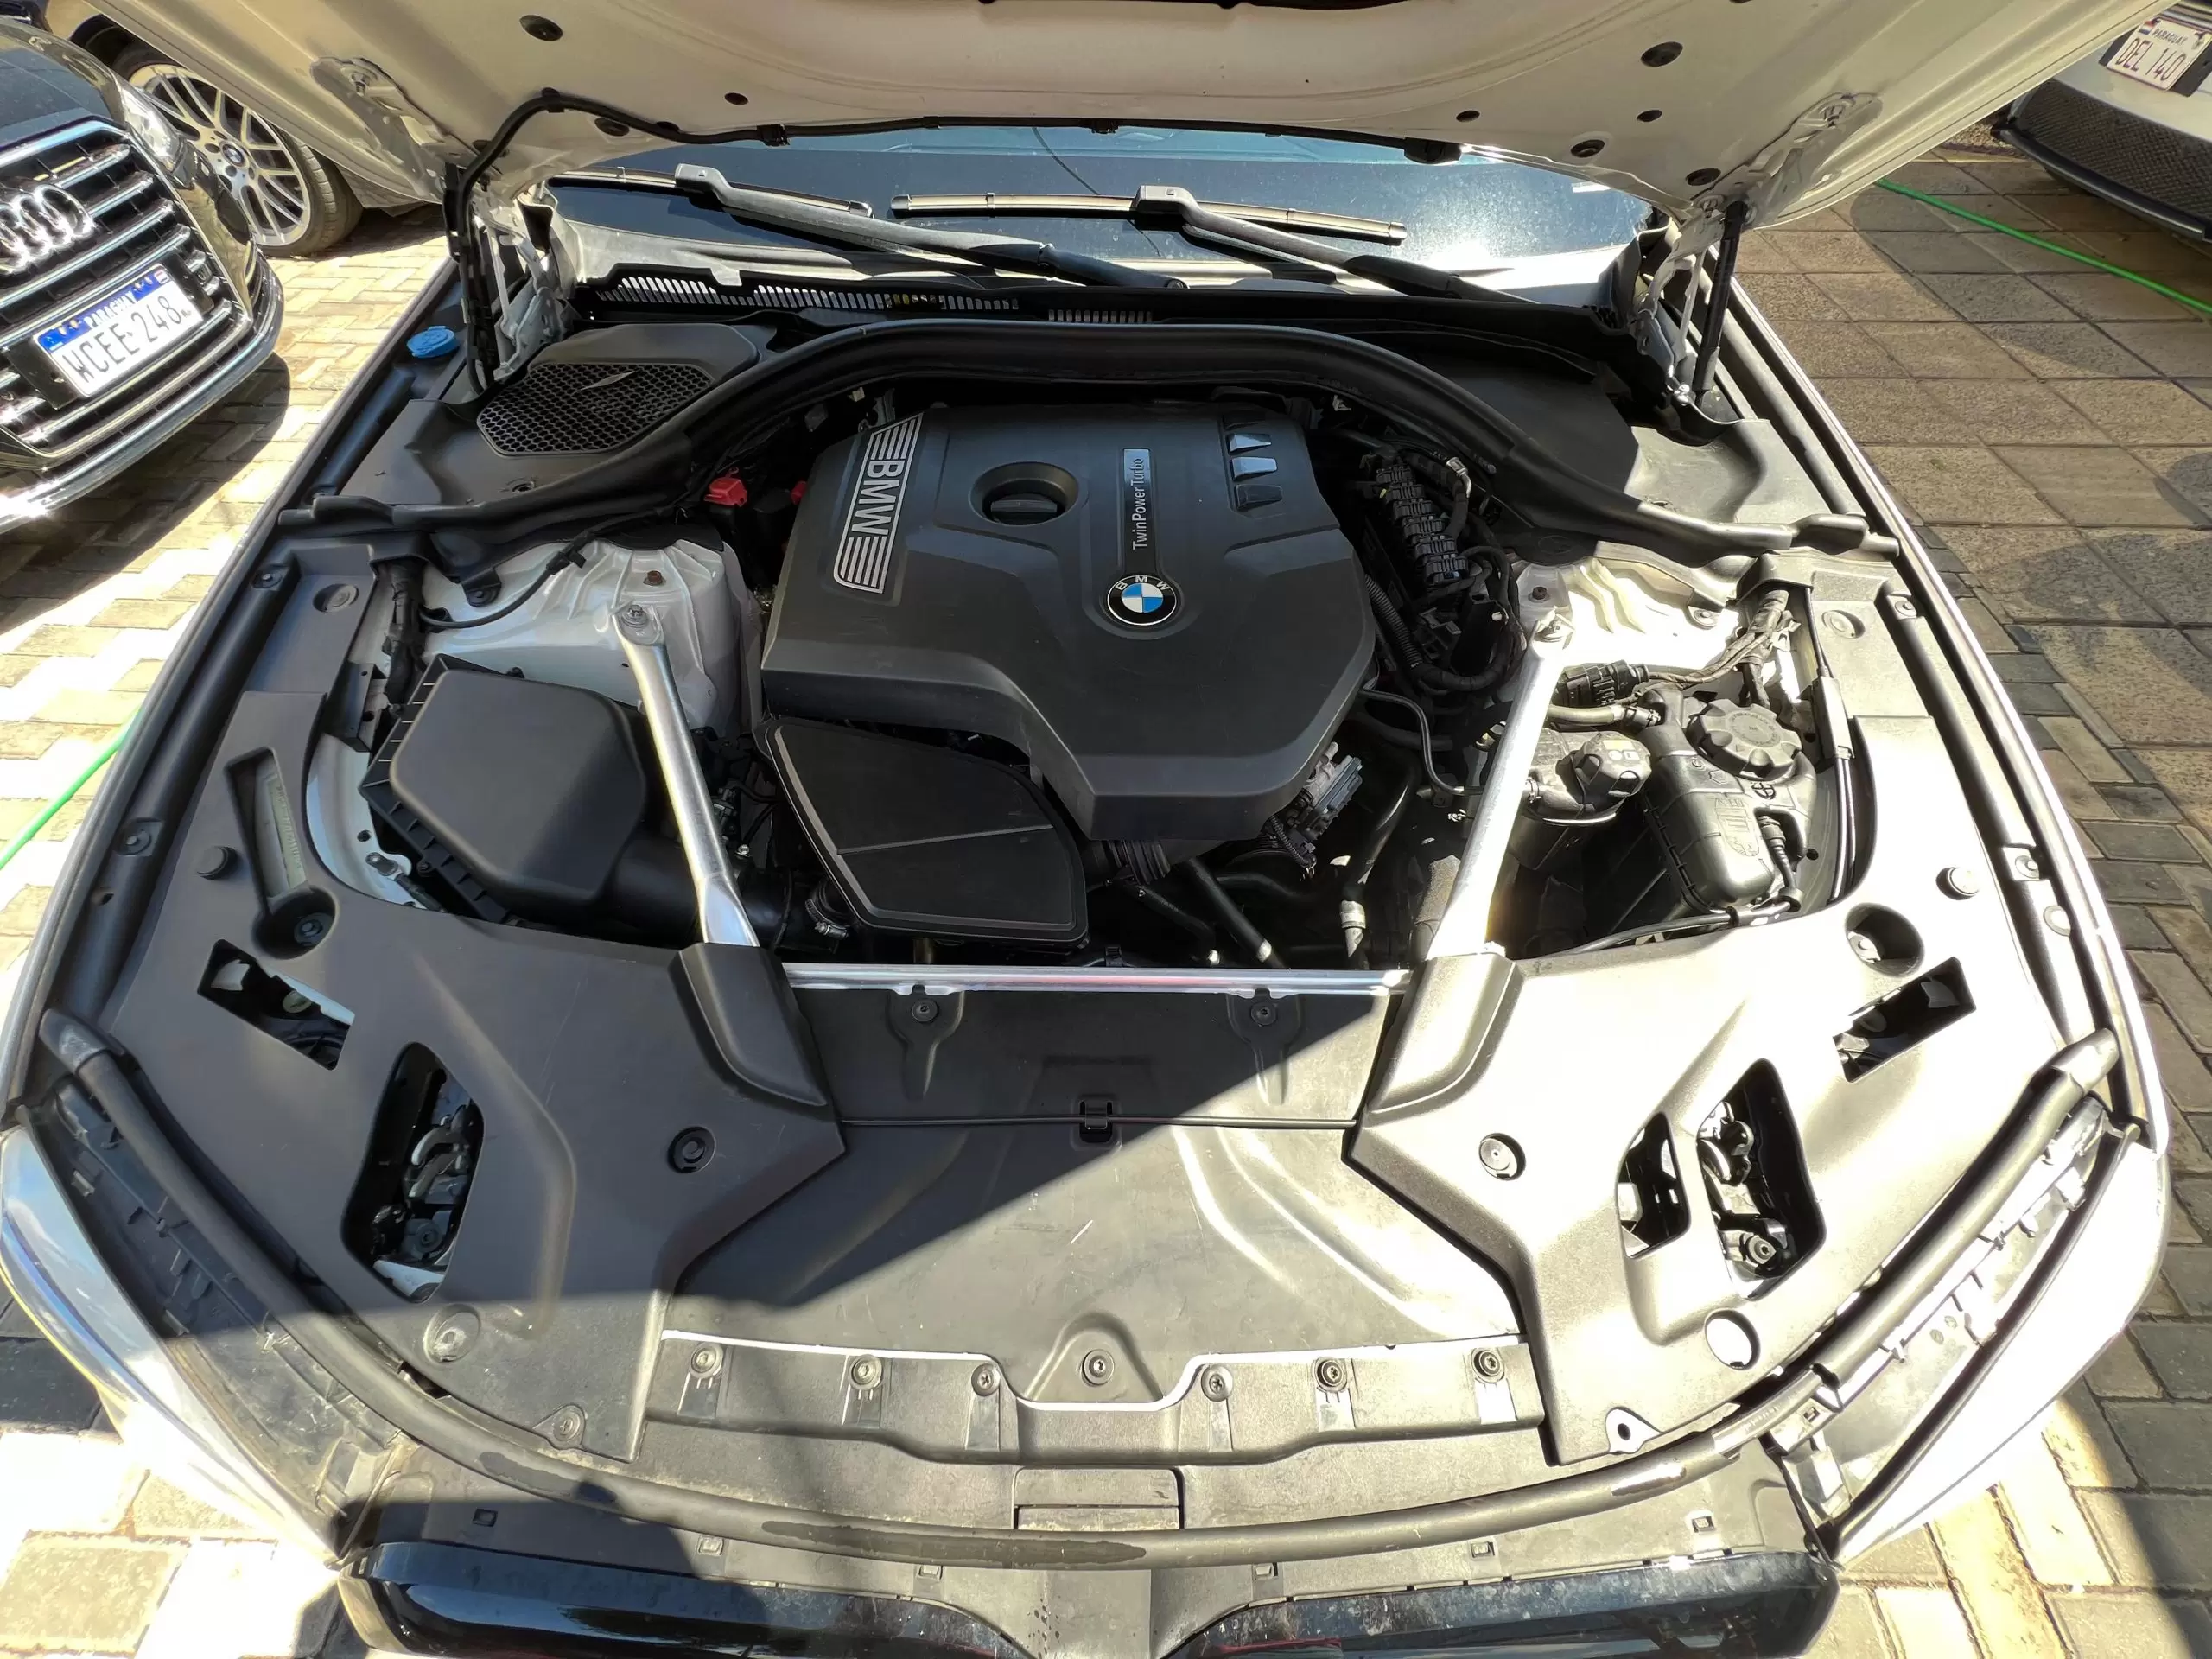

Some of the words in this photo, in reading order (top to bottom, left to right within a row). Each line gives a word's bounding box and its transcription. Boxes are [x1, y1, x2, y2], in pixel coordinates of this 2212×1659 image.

[2152, 29, 2188, 46] PARAGUAY
[2115, 38, 2154, 73] DEL
[2145, 48, 2186, 81] 140
[131, 296, 181, 342] 248
[1130, 458, 1145, 486] Turbo
[851, 460, 906, 536] BMW
[1131, 486, 1147, 550] TwinPower
[1115, 575, 1169, 591] BMW
